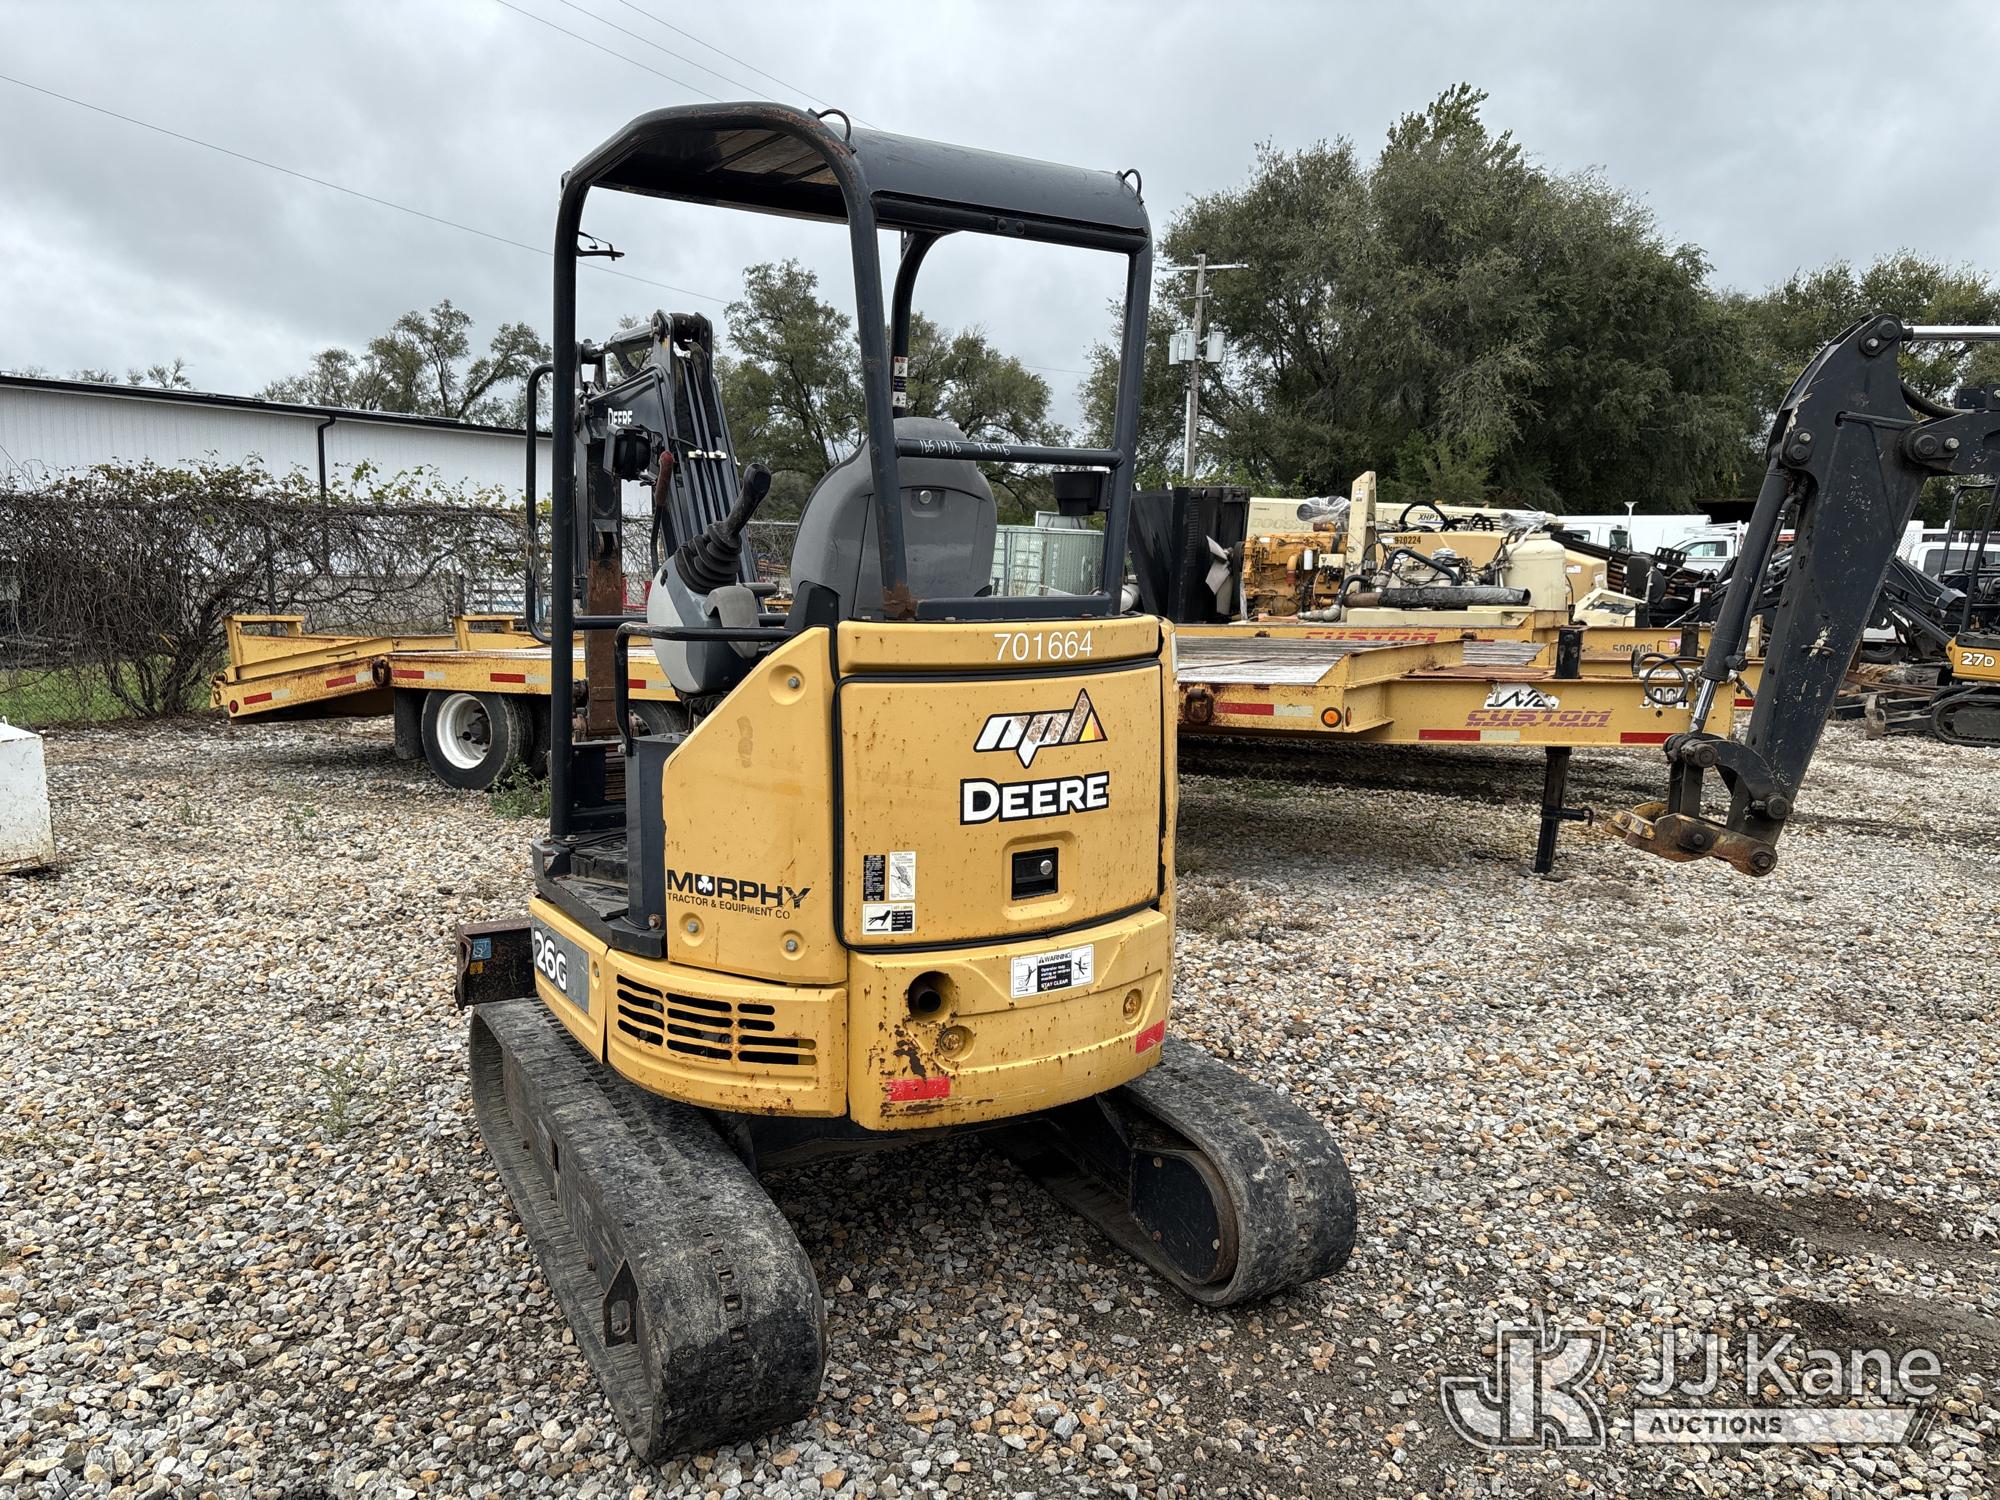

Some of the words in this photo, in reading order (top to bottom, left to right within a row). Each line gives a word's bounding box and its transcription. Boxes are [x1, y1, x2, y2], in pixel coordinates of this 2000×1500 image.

[994, 630, 1093, 661] 701664
[1961, 652, 1995, 667] 27D
[1467, 710, 1613, 722] CUSTOM
[961, 772, 1109, 823] DEERE
[667, 869, 812, 909] MURPHY
[667, 893, 709, 907] TRACTOR
[711, 900, 717, 908] &
[719, 901, 773, 917] EQUIPMENT
[775, 909, 791, 920] CO
[534, 930, 567, 991] 26G
[1044, 952, 1072, 962] WARNING
